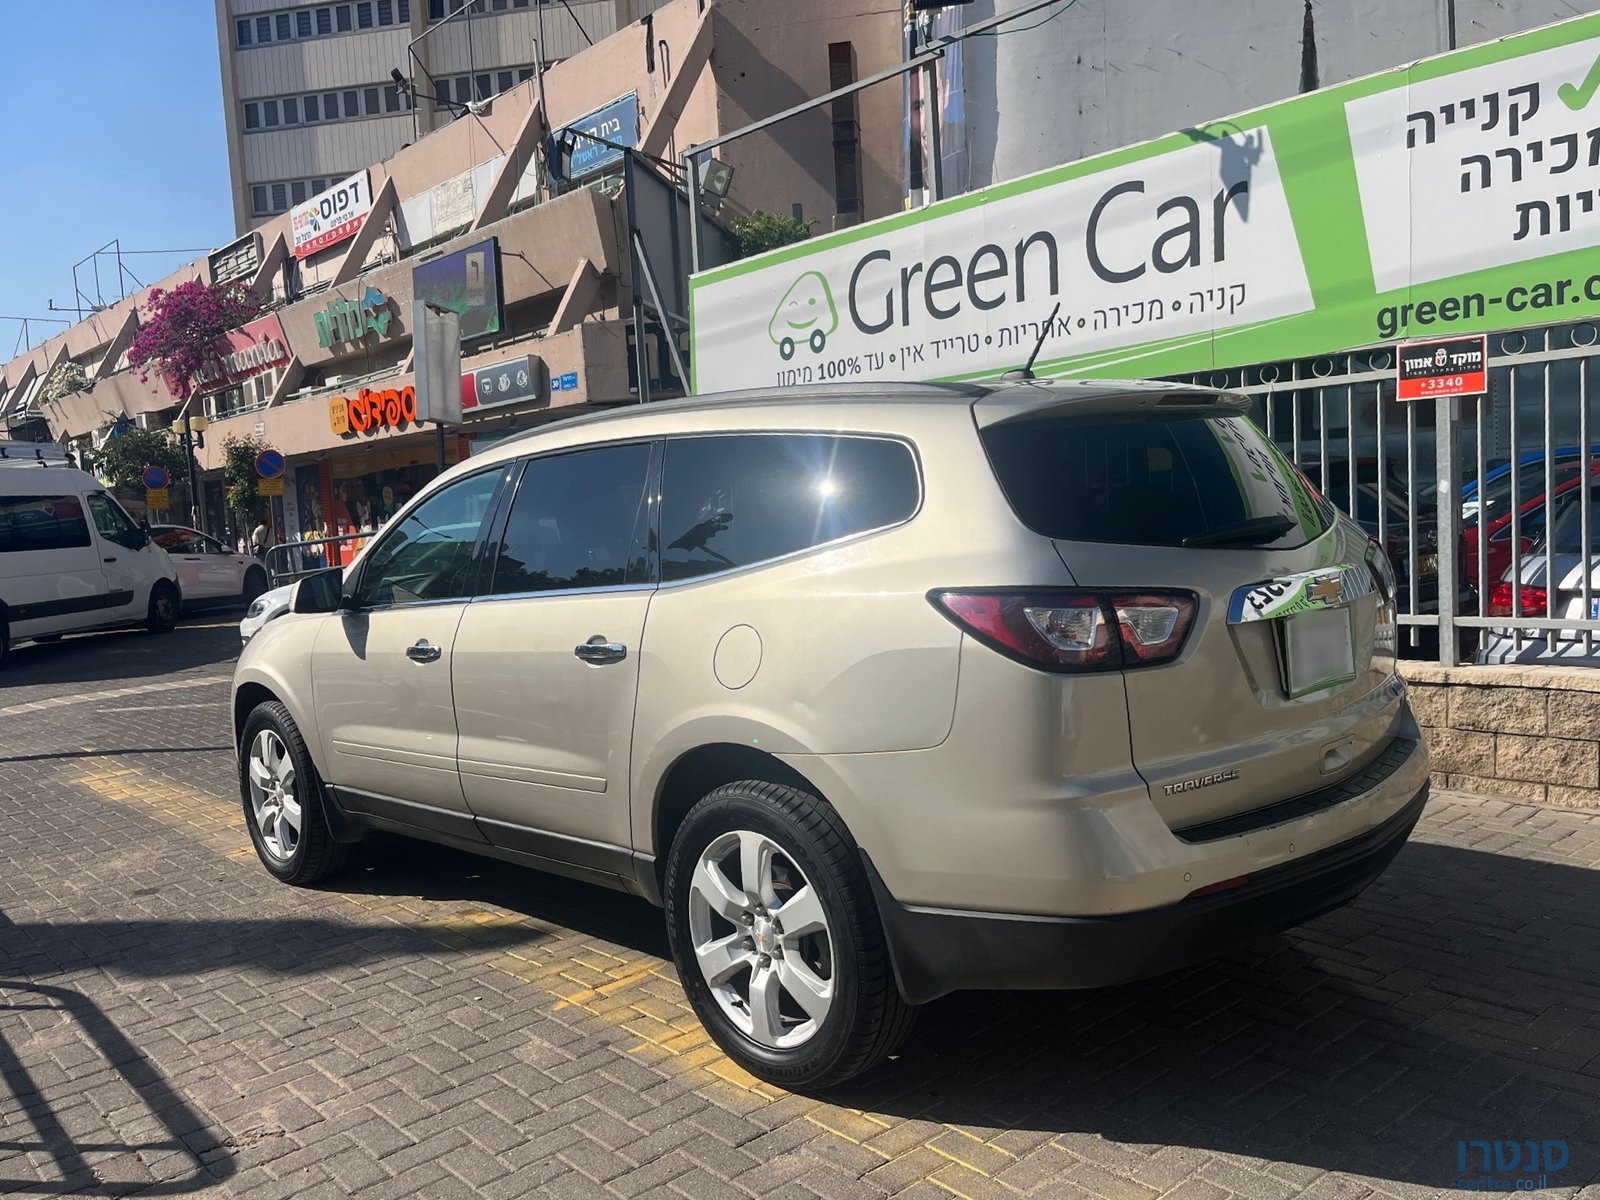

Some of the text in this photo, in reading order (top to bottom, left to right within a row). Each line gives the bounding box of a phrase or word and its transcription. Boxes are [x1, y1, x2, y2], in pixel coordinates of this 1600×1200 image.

[601, 118, 620, 137] בית
[1406, 82, 1540, 149] קנייה
[320, 182, 359, 220] דפוס
[1513, 189, 1600, 241] יות
[848, 180, 1248, 335] Green Car
[1189, 283, 1246, 315] קניה
[1093, 298, 1164, 331] מכירה
[930, 333, 979, 359] טרייד
[998, 315, 1071, 348] אחריות
[818, 356, 861, 381] 100%
[864, 352, 884, 372] עד
[900, 343, 924, 371] אין
[1404, 351, 1481, 373] מוקד אמון
[1163, 768, 1240, 796] TRAVERSE
